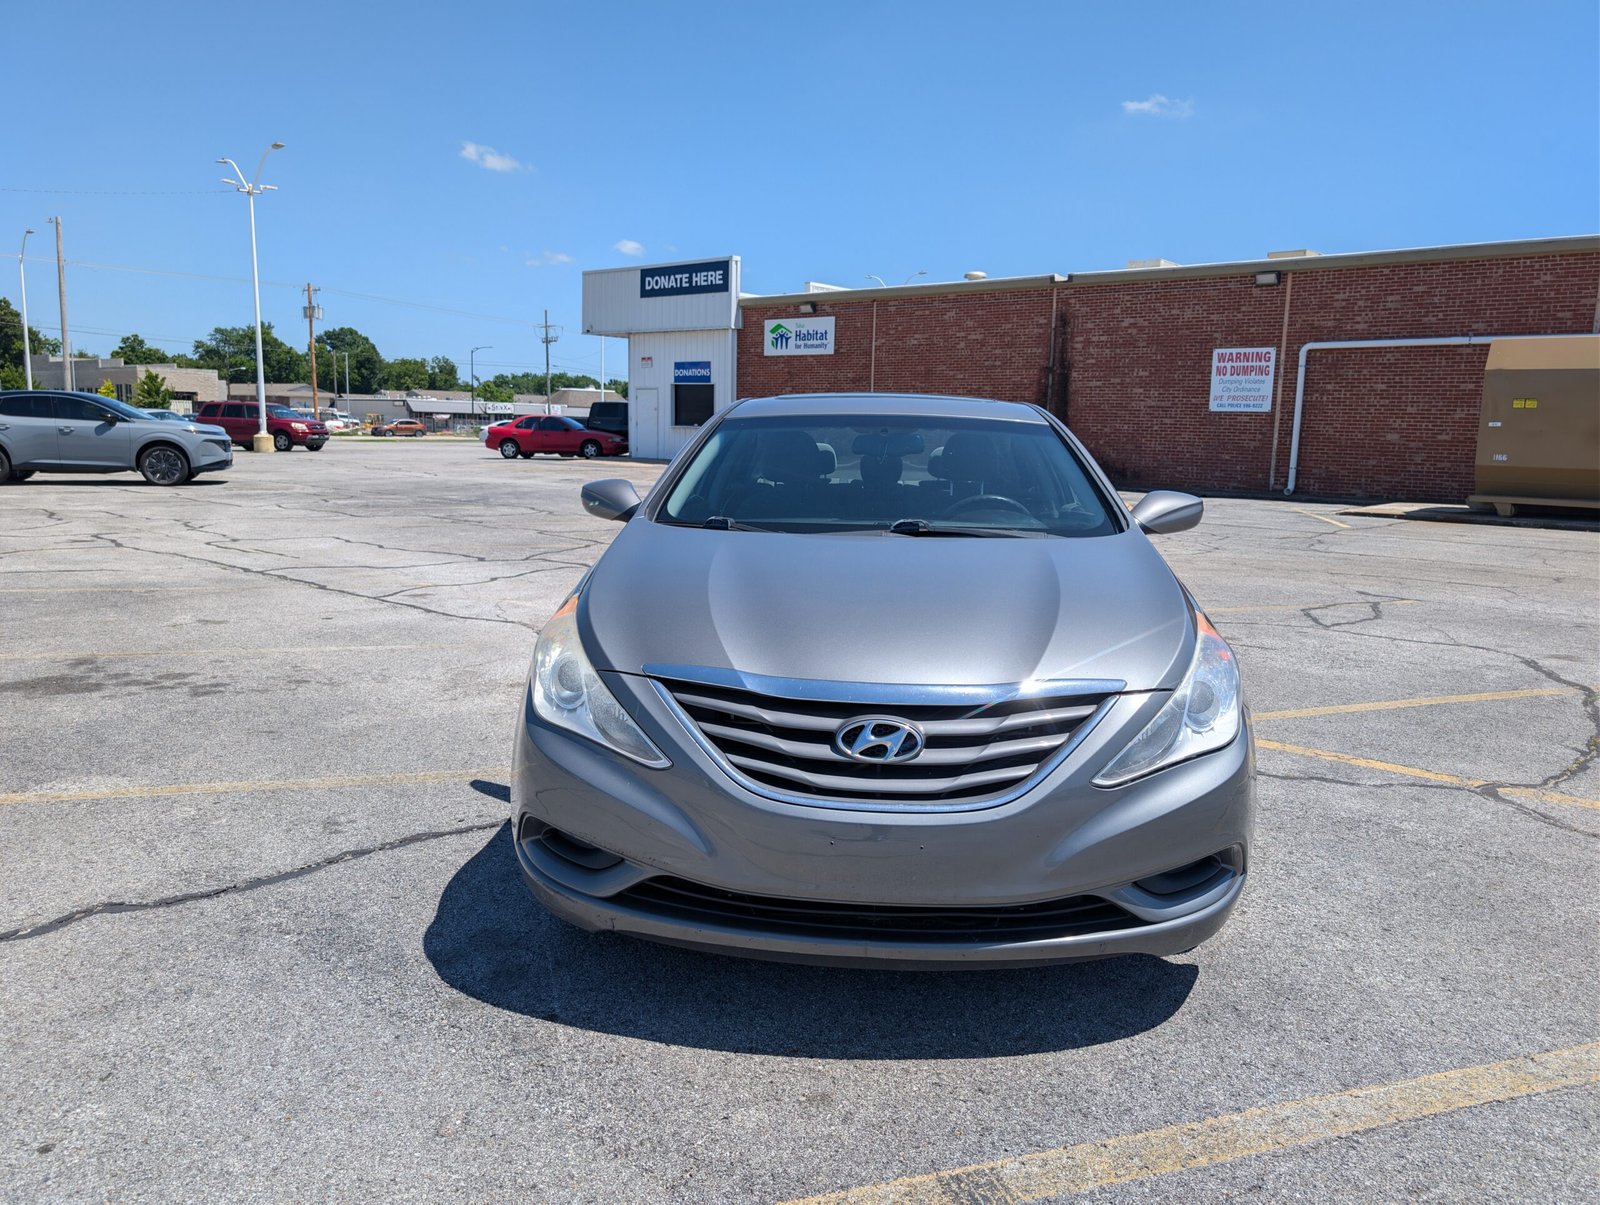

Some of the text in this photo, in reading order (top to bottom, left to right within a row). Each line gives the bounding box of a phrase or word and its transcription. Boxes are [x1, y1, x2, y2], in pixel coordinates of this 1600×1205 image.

[645, 270, 724, 290] DONATE HERE
[794, 329, 828, 342] Habitat
[803, 342, 828, 351] Humanity
[1217, 351, 1271, 363] WARNING
[674, 368, 711, 377] DONATIONS
[1216, 365, 1271, 377] NO DUMPING
[1218, 378, 1243, 386] Dumping
[1213, 394, 1269, 402] WE PROSECUTE!
